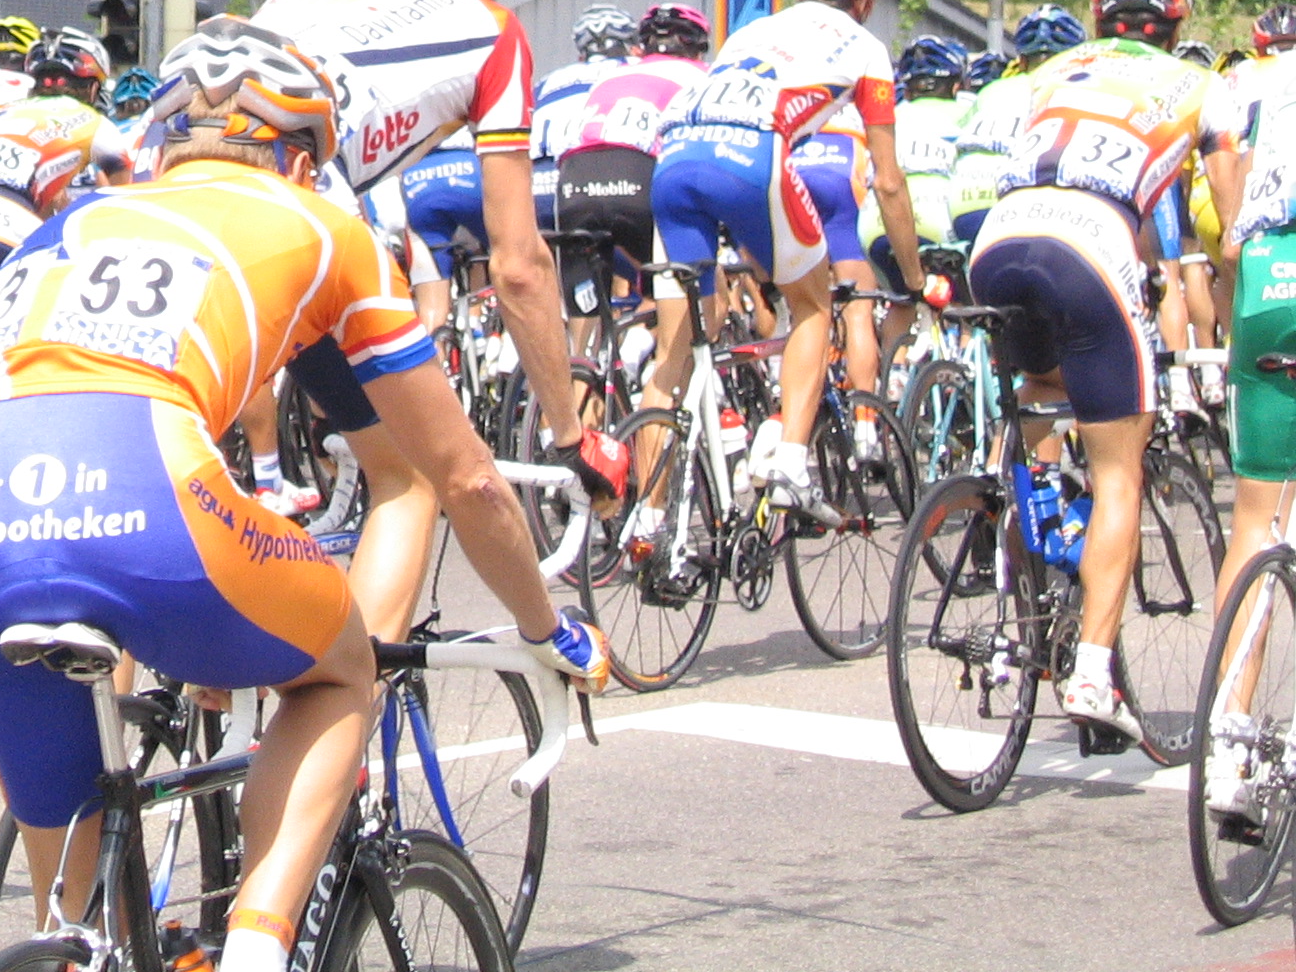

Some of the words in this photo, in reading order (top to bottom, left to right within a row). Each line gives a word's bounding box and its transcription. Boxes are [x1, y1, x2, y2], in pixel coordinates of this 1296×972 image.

[361, 105, 421, 165] Lotto
[1081, 133, 1132, 175] 32
[403, 160, 475, 186] COFIDIS
[1027, 202, 1105, 238] Balears
[78, 255, 174, 318] 53
[54, 310, 177, 349] KONICA
[74, 462, 107, 494] in
[240, 516, 333, 566] Hypothek
